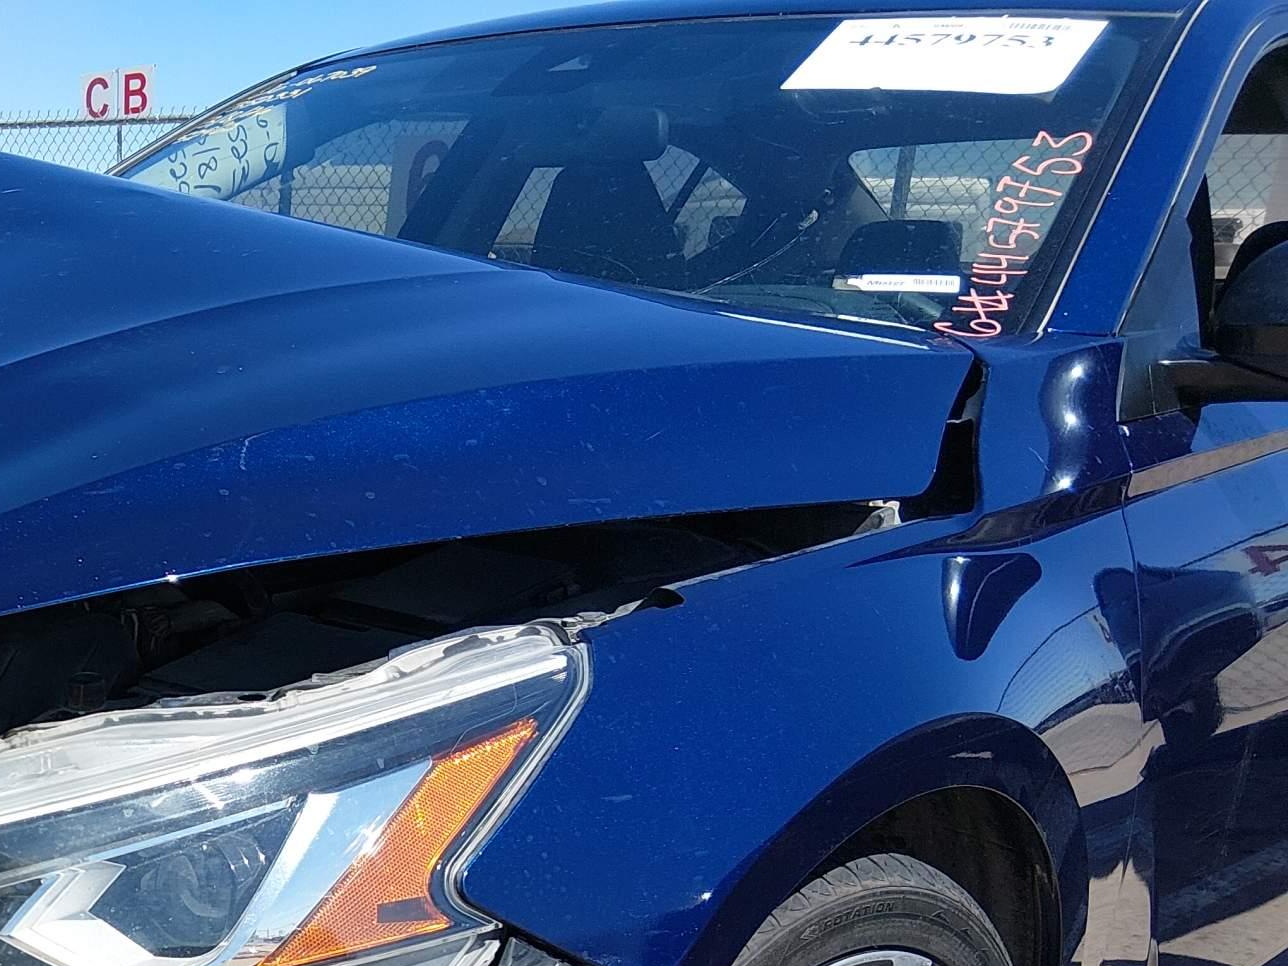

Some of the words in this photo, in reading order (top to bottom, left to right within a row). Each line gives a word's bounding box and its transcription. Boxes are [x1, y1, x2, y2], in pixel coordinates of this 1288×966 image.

[85, 77, 110, 118] C
[123, 72, 148, 114] B
[821, 901, 897, 933] ROTATION
